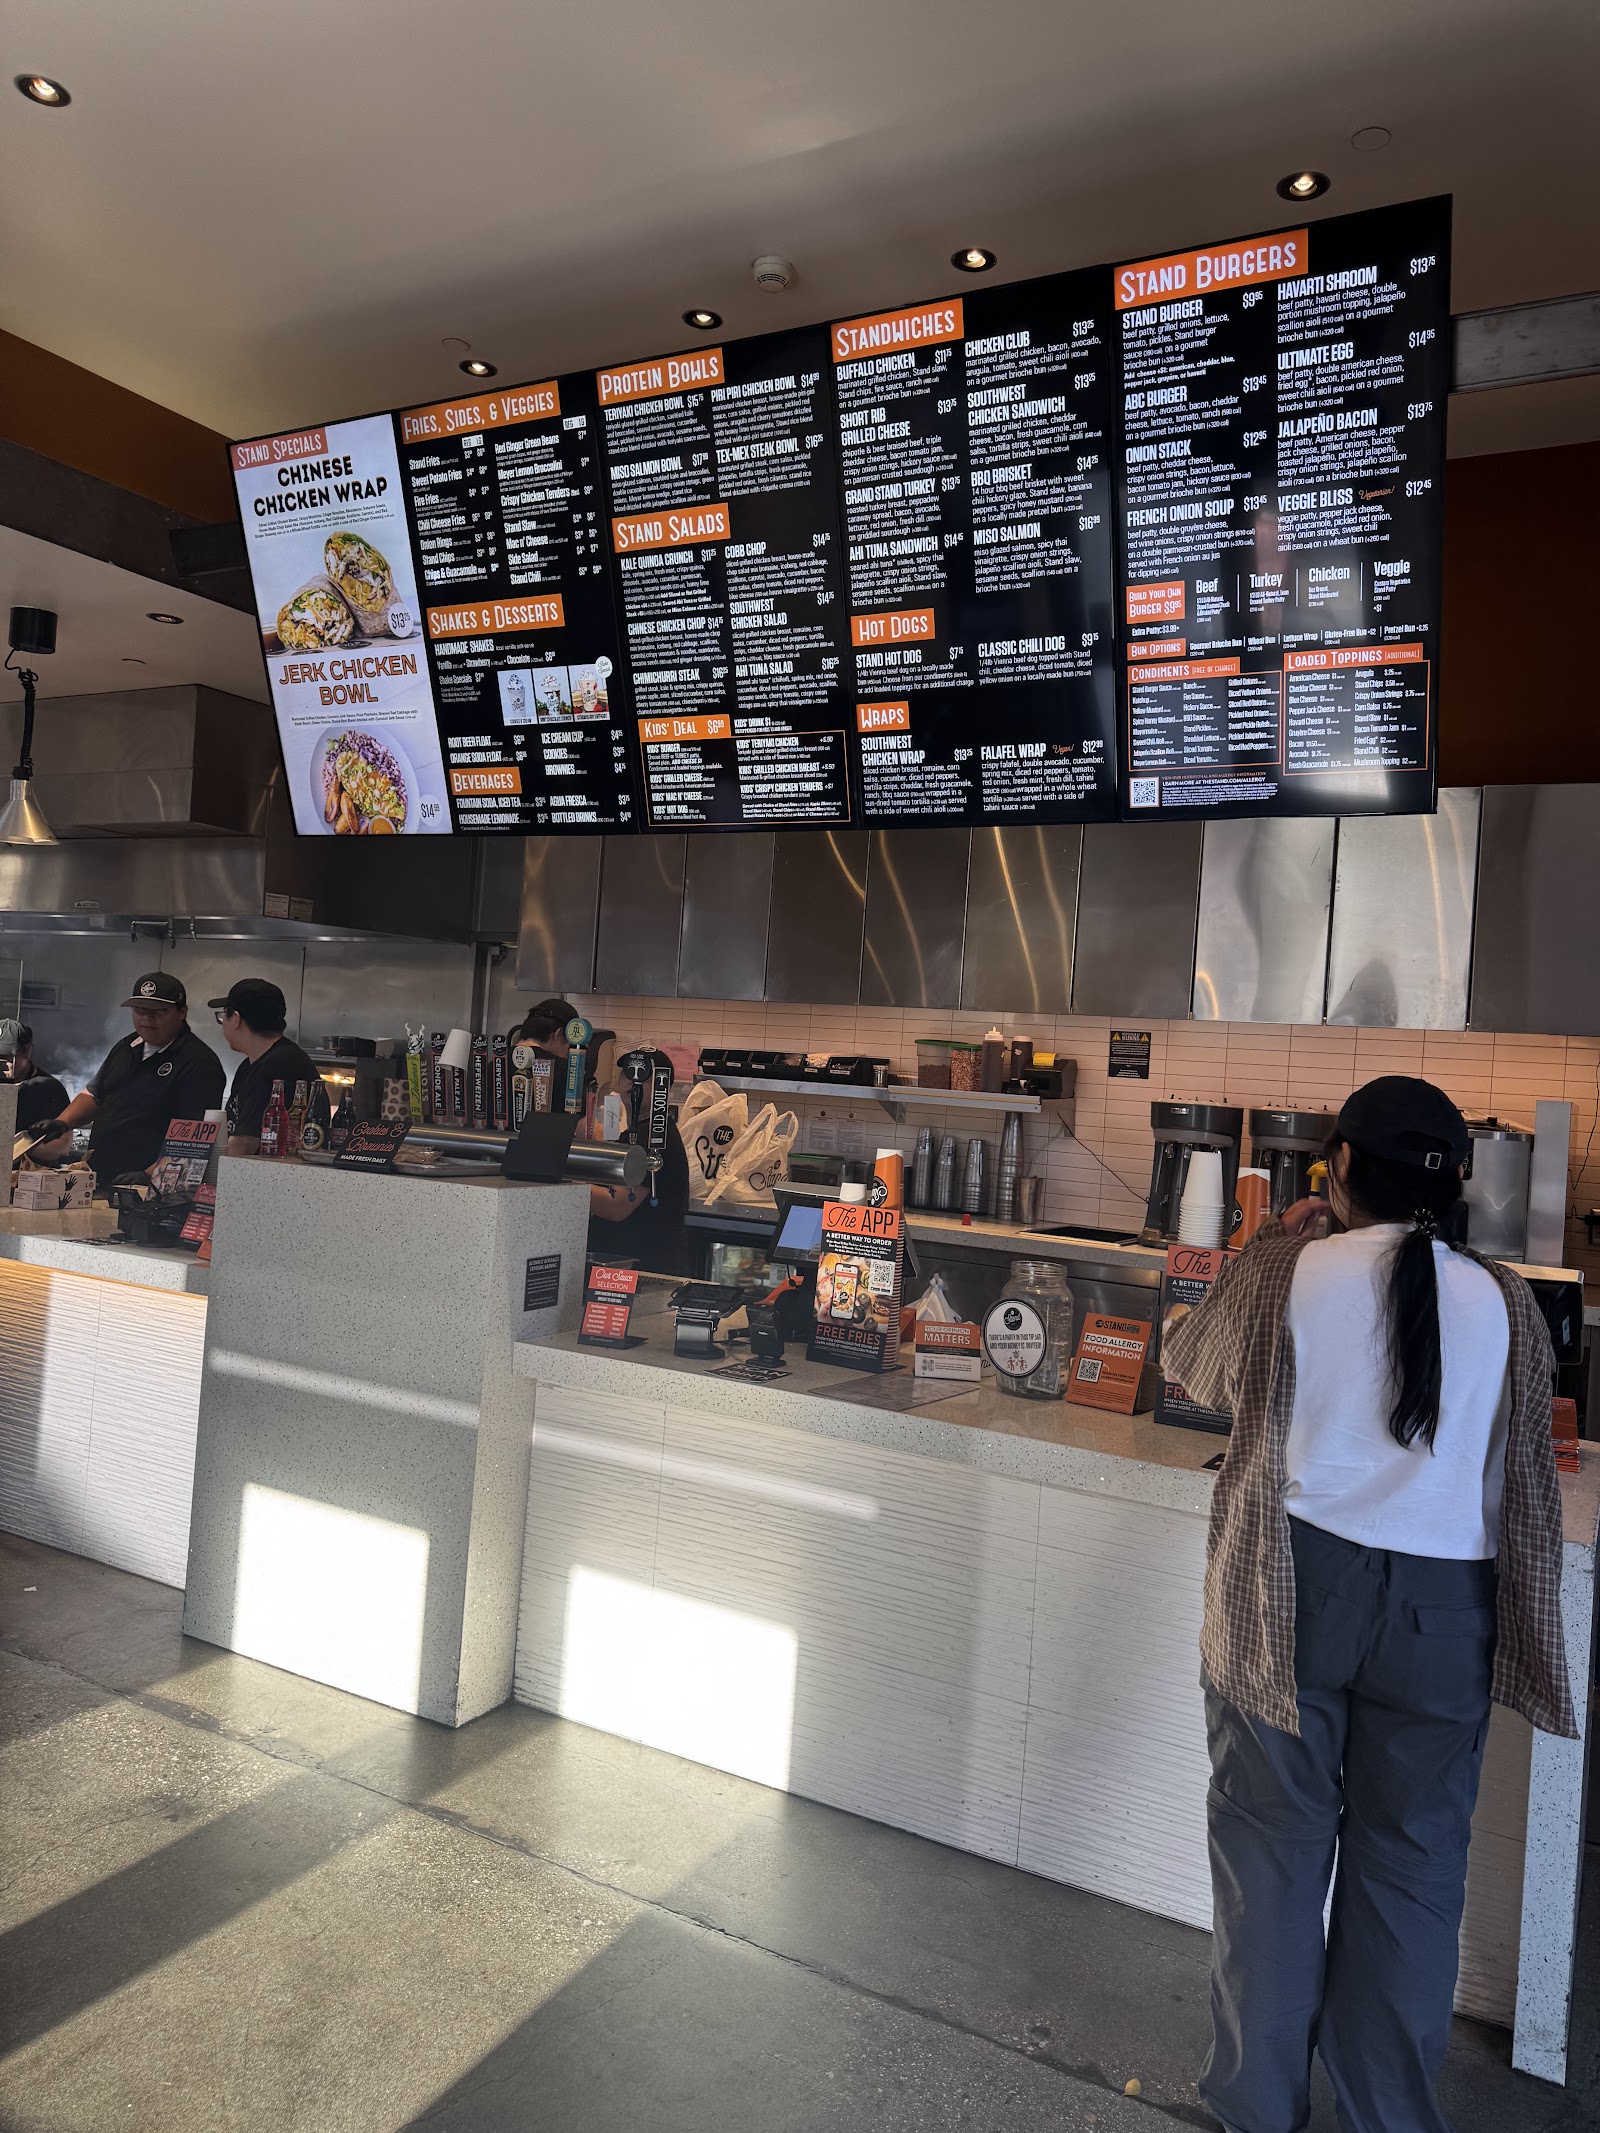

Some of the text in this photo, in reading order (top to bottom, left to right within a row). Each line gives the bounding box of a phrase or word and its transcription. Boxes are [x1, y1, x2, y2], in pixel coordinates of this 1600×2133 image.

[1120, 242, 1296, 303] STAND BURGERS
[1278, 266, 1377, 301] HAVARTI SHROOM
[1123, 299, 1203, 329] STAND BURGER
[836, 309, 955, 356] STANDWICHES
[965, 331, 1030, 357] CHICKEN CLUB
[836, 353, 915, 381] BUFFALO CHICKEN
[1277, 342, 1354, 370] ULTIMATE EGG
[601, 356, 719, 401] PROTEIN BOWLS
[711, 376, 796, 402] PIRI PIRI CHICKEN BOWL
[967, 384, 1026, 408] SOUTHWEST
[1125, 385, 1187, 411] ABC BURGER
[404, 391, 554, 439] FRIES, SIDES, & VEGGIES
[840, 407, 886, 429] SHORT RIB
[968, 396, 1065, 426] CHICKEN SANDWICH
[1278, 408, 1377, 438] JALAPEÑO BACON
[841, 421, 911, 447] GRILLED CHEESE
[237, 433, 322, 468] STAND SPECIALS
[716, 437, 799, 464] TEX-MEX STEAK BOWL
[1126, 439, 1191, 464] ONION STACK
[278, 455, 353, 487] CHINESE
[971, 464, 1032, 487] BBQ BRISKET
[254, 476, 388, 517] CHICKEN WRAP
[845, 478, 935, 505] GRAND STAND TURKEY
[1278, 492, 1317, 513] VEGGIE
[1319, 488, 1353, 508] BLISS
[1127, 499, 1234, 527] FRENCH ONION SOUP
[617, 512, 725, 549] STAND SALADS
[974, 523, 1041, 545] MISO SALMON
[849, 536, 938, 562] AHI TUNA SANDWICH
[1196, 559, 1410, 594] Beef Turkey Chicken Veggie
[1129, 588, 1181, 602] BUILD YOUR OWN
[430, 602, 558, 635] SHAKES & DESSERTS
[1129, 602, 1161, 618] BURGER
[859, 615, 928, 641] HOT DOGS
[856, 649, 921, 669] STAND HOT DOG
[978, 636, 1065, 657] CLASSIC CHILI DOG
[1131, 643, 1181, 657] BUN OPTIONS
[279, 654, 417, 685] JERK CHICKEN
[1288, 650, 1383, 669] LOADED TOPPINGS
[1131, 665, 1190, 681] CONDIMENTS
[319, 683, 378, 705] BOWL
[674, 720, 697, 735] DEAL
[861, 708, 904, 729] WRAPS
[861, 735, 912, 751] SOUTHWEST
[981, 743, 1046, 760] FALAFEL WRAP
[862, 750, 925, 767] CHICKEN WRAP
[453, 772, 514, 792] BEVERAGES
[474, 1056, 482, 1111] HEFEWEIZEN
[653, 1088, 666, 1133] OLD SOUL
[170, 1122, 216, 1141] The APP
[352, 1121, 389, 1137] Cookies
[390, 1122, 406, 1137] &
[716, 1129, 732, 1141] THE
[347, 1137, 395, 1152] Brownies
[827, 1207, 893, 1234] The APP
[1173, 1250, 1211, 1274] The
[596, 1269, 633, 1281] Our Sauce
[597, 1281, 628, 1290] SELECTION
[816, 1325, 880, 1345] FREE FRIES
[925, 1333, 970, 1344] MATTERS
[1085, 1334, 1142, 1349] FOOD ALLERGY
[1082, 1344, 1141, 1360] INFORMATION
